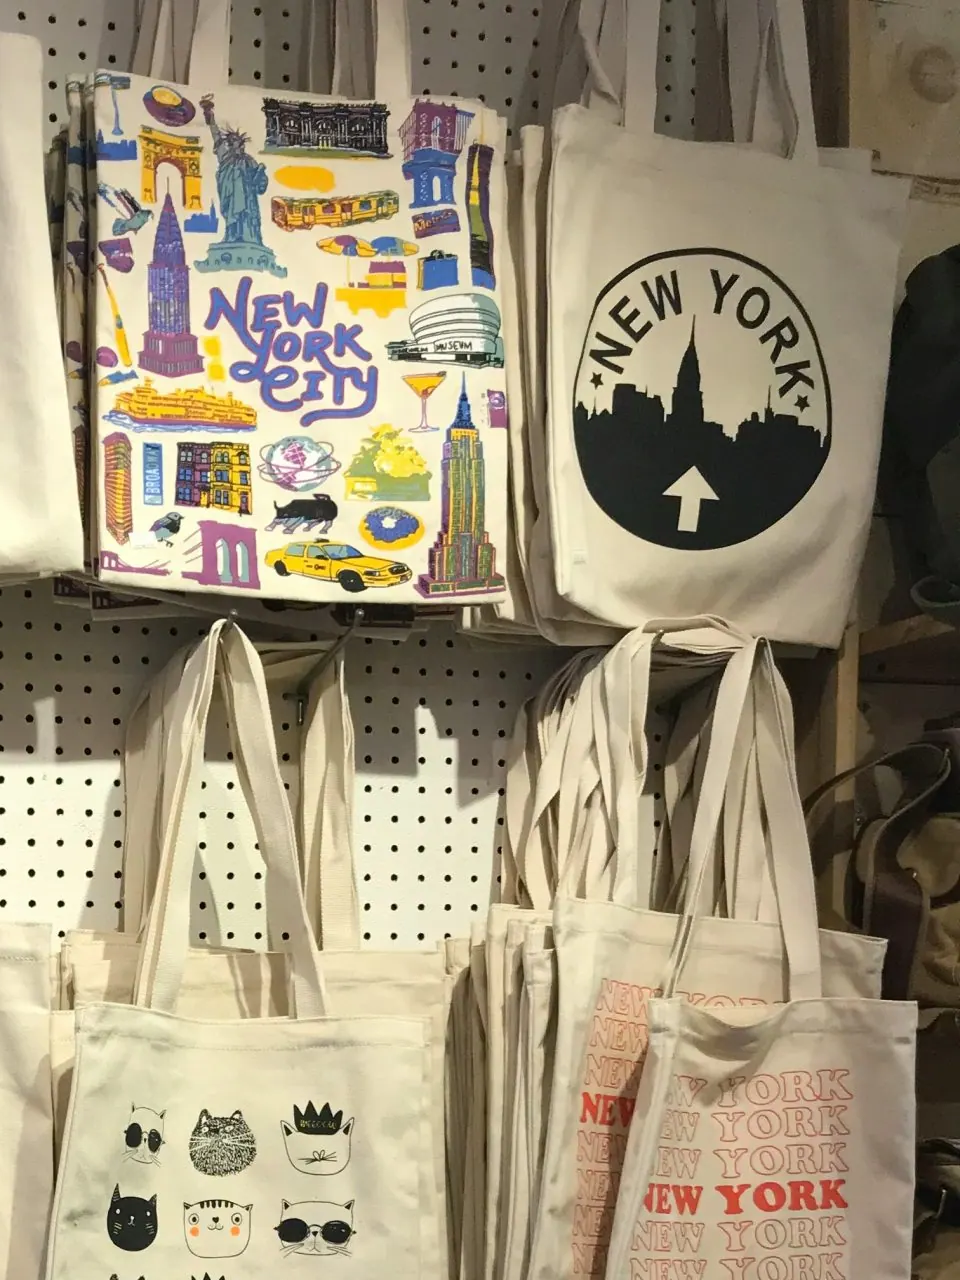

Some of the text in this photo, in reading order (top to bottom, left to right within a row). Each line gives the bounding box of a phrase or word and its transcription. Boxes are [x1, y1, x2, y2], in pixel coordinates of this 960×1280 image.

[204, 276, 328, 355] NEW
[589, 268, 815, 399] NEW YORK
[229, 321, 373, 383] YORK
[717, 1069, 853, 1108] YORK
[711, 1105, 850, 1143] YORK
[652, 1142, 849, 1179] EW YORK
[715, 1179, 848, 1216] YORK
[631, 1216, 846, 1253] NEW YORK
